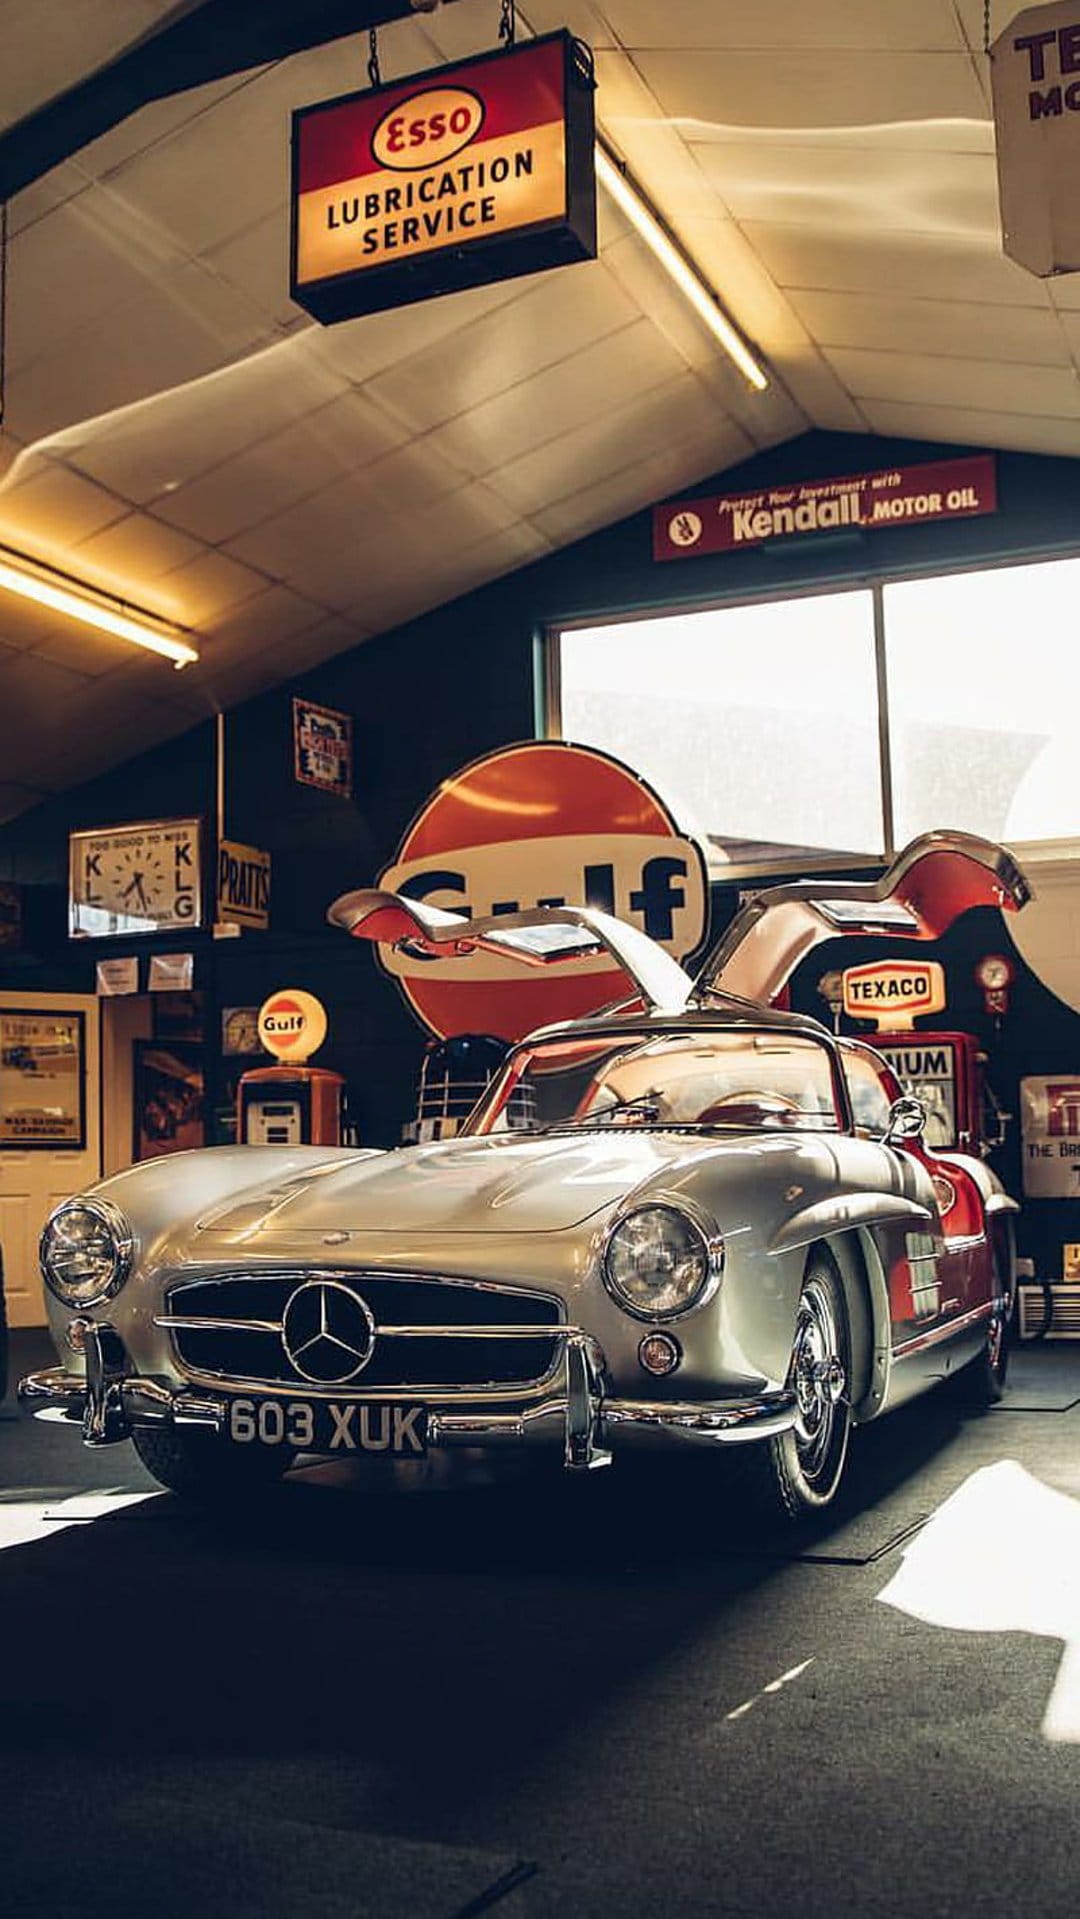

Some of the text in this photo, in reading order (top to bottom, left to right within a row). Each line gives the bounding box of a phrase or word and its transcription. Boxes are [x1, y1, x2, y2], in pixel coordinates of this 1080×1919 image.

[327, 149, 533, 230] LUBRICATION
[362, 196, 496, 255] SERVICE
[871, 472, 902, 490] with
[732, 488, 979, 541] Kendall MOTOR OIL
[850, 978, 927, 1000] TEXACO
[263, 1017, 304, 1031] Gulf
[1027, 1143, 1053, 1158] THE
[231, 1399, 424, 1451] 603 XUK
